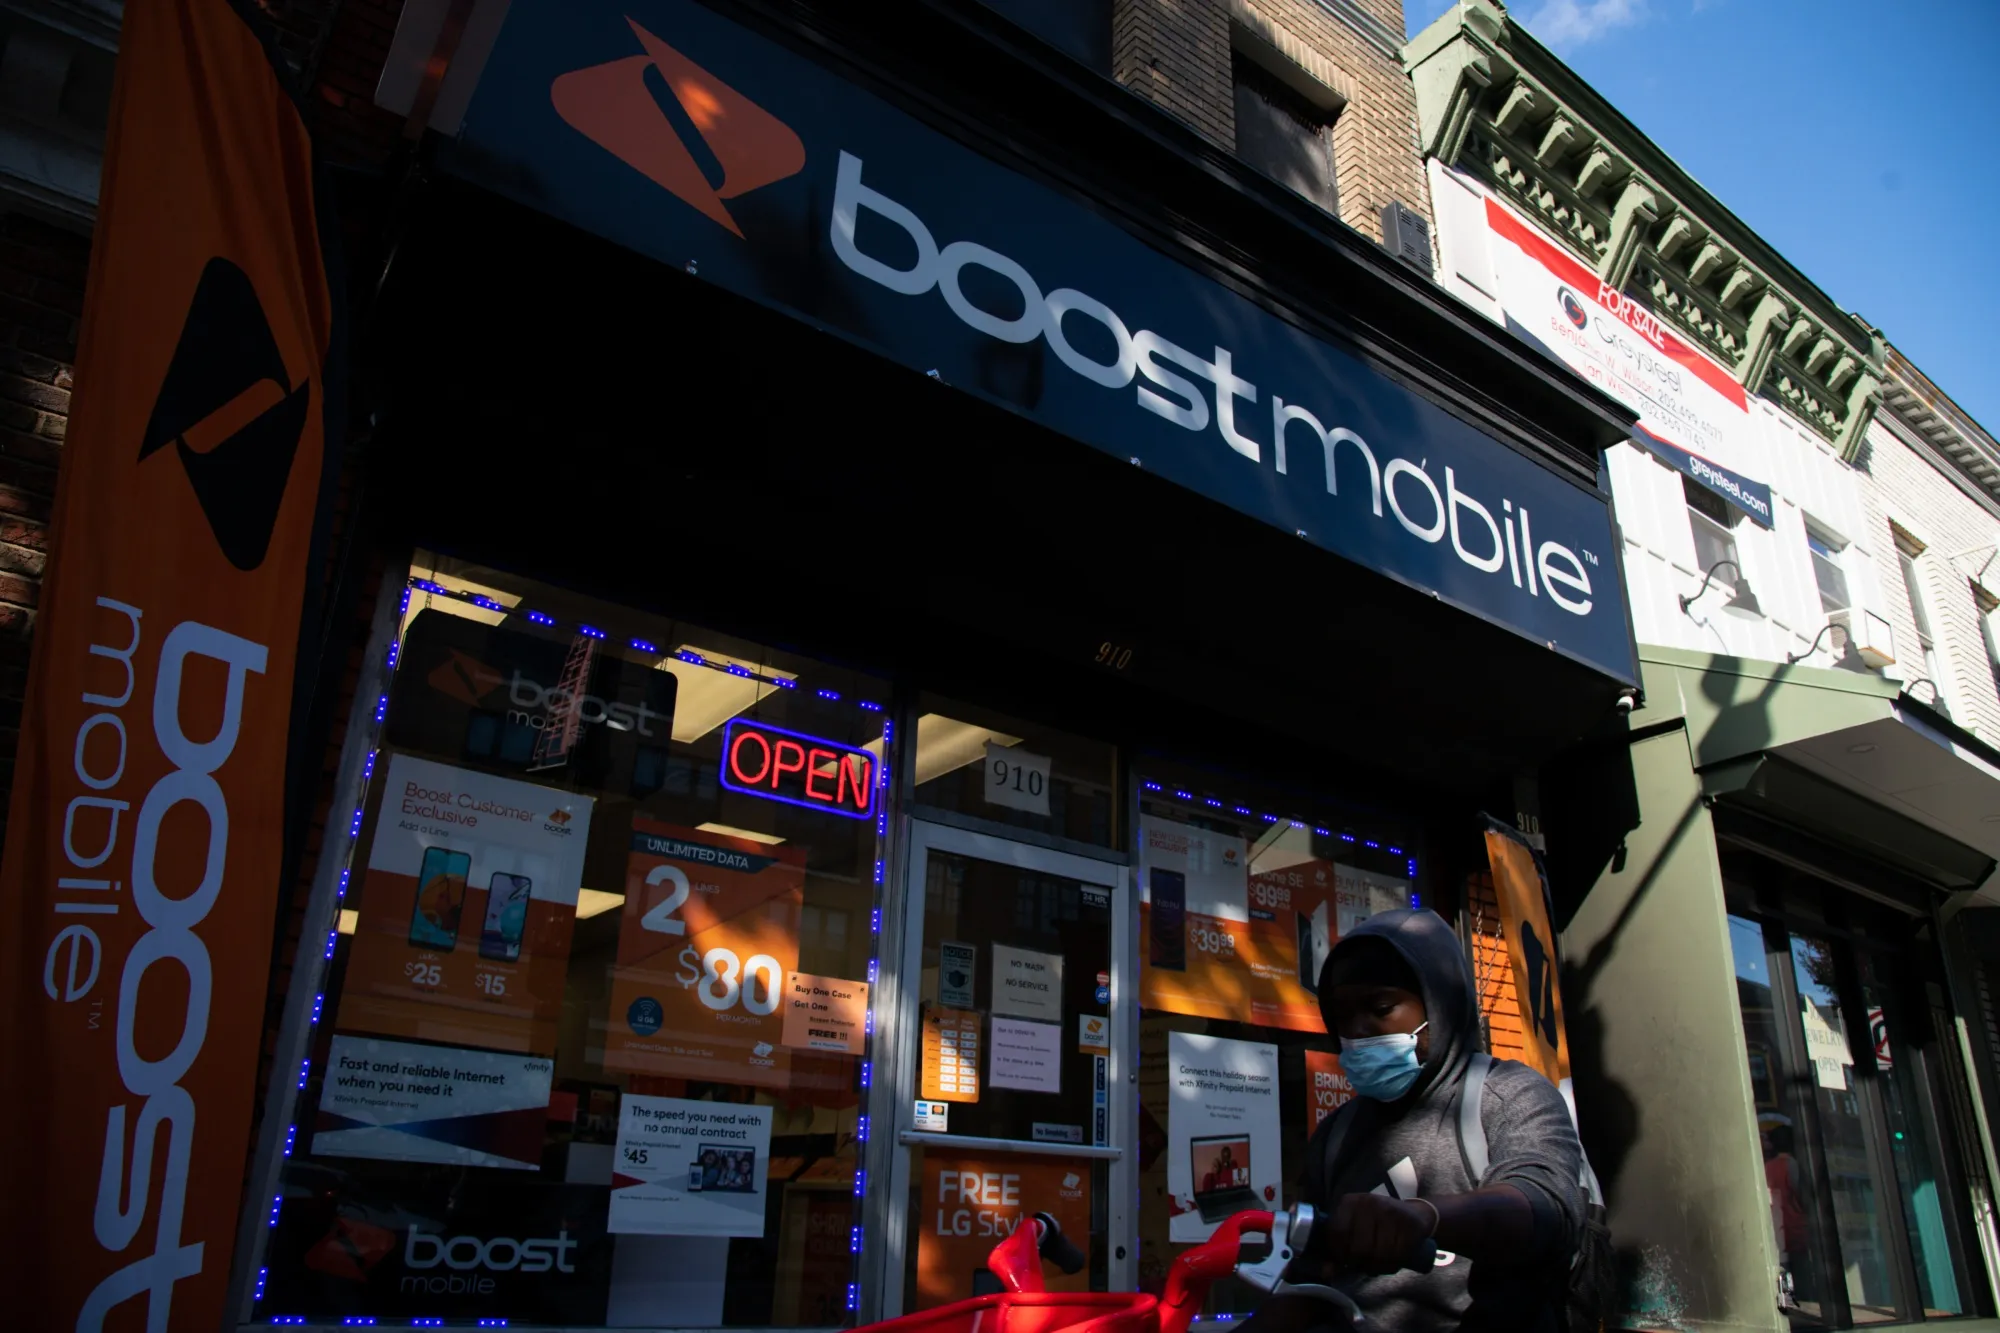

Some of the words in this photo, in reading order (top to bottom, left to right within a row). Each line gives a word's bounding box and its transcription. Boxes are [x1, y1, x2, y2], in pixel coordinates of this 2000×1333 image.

[1597, 283, 1629, 322] FOR
[1632, 309, 1665, 350] SALE
[831, 149, 1260, 464] boost
[1274, 394, 1592, 616] mobile
[1690, 456, 1769, 516] greysteel.com
[1094, 641, 1133, 671] 910
[509, 669, 656, 737] boost
[730, 730, 871, 810] OPEN
[993, 760, 1043, 796] 910
[44, 595, 145, 1003] mobile
[405, 781, 452, 806] Boost
[457, 794, 535, 822] Customer
[402, 799, 477, 827] Exclusive
[1517, 811, 1538, 834] 910
[398, 820, 418, 832] Add
[544, 823, 573, 836] boost
[647, 838, 716, 862] UNLIMITED
[717, 852, 749, 869] DATA
[1288, 872, 1304, 889] SE
[640, 864, 690, 936] 2
[77, 620, 269, 1333] boost
[404, 961, 442, 986] $25
[1011, 960, 1022, 968] NO
[475, 973, 506, 996] $15
[674, 944, 783, 1016] $80
[795, 985, 811, 995] Buy
[813, 988, 830, 996] One
[832, 990, 852, 999] Case
[1006, 979, 1017, 987] NO
[1018, 980, 1049, 992] SERVICE
[794, 1000, 809, 1008] Get
[812, 1002, 828, 1011] One
[808, 1028, 837, 1039] FREE
[340, 1056, 369, 1071] Fast
[372, 1061, 399, 1074] and
[403, 1064, 450, 1080] reliable
[454, 1069, 505, 1085] Internet
[1180, 1065, 1208, 1077] Connect
[1209, 1068, 1221, 1077] this
[1223, 1070, 1246, 1082] holiday
[1248, 1074, 1270, 1082] season
[1315, 1072, 1352, 1091] BRING
[338, 1075, 375, 1090] when
[379, 1081, 404, 1094] you
[408, 1081, 440, 1096] need
[443, 1086, 453, 1097] it
[1179, 1079, 1194, 1088] with
[1196, 1080, 1218, 1091] Xfinity
[1220, 1082, 1244, 1093] Prepaid
[1245, 1085, 1271, 1095] Internet
[632, 1105, 651, 1117] The
[654, 1110, 685, 1121] speed
[687, 1113, 707, 1123] you
[709, 1114, 736, 1124] need
[738, 1115, 761, 1126] with
[644, 1123, 659, 1133] no
[661, 1125, 699, 1136] annual
[700, 1128, 747, 1139] contract
[623, 1147, 648, 1164] $45
[938, 1169, 1020, 1206] FREE
[936, 1208, 972, 1237] LG
[404, 1223, 577, 1273] boost
[400, 1273, 496, 1294] mobile
